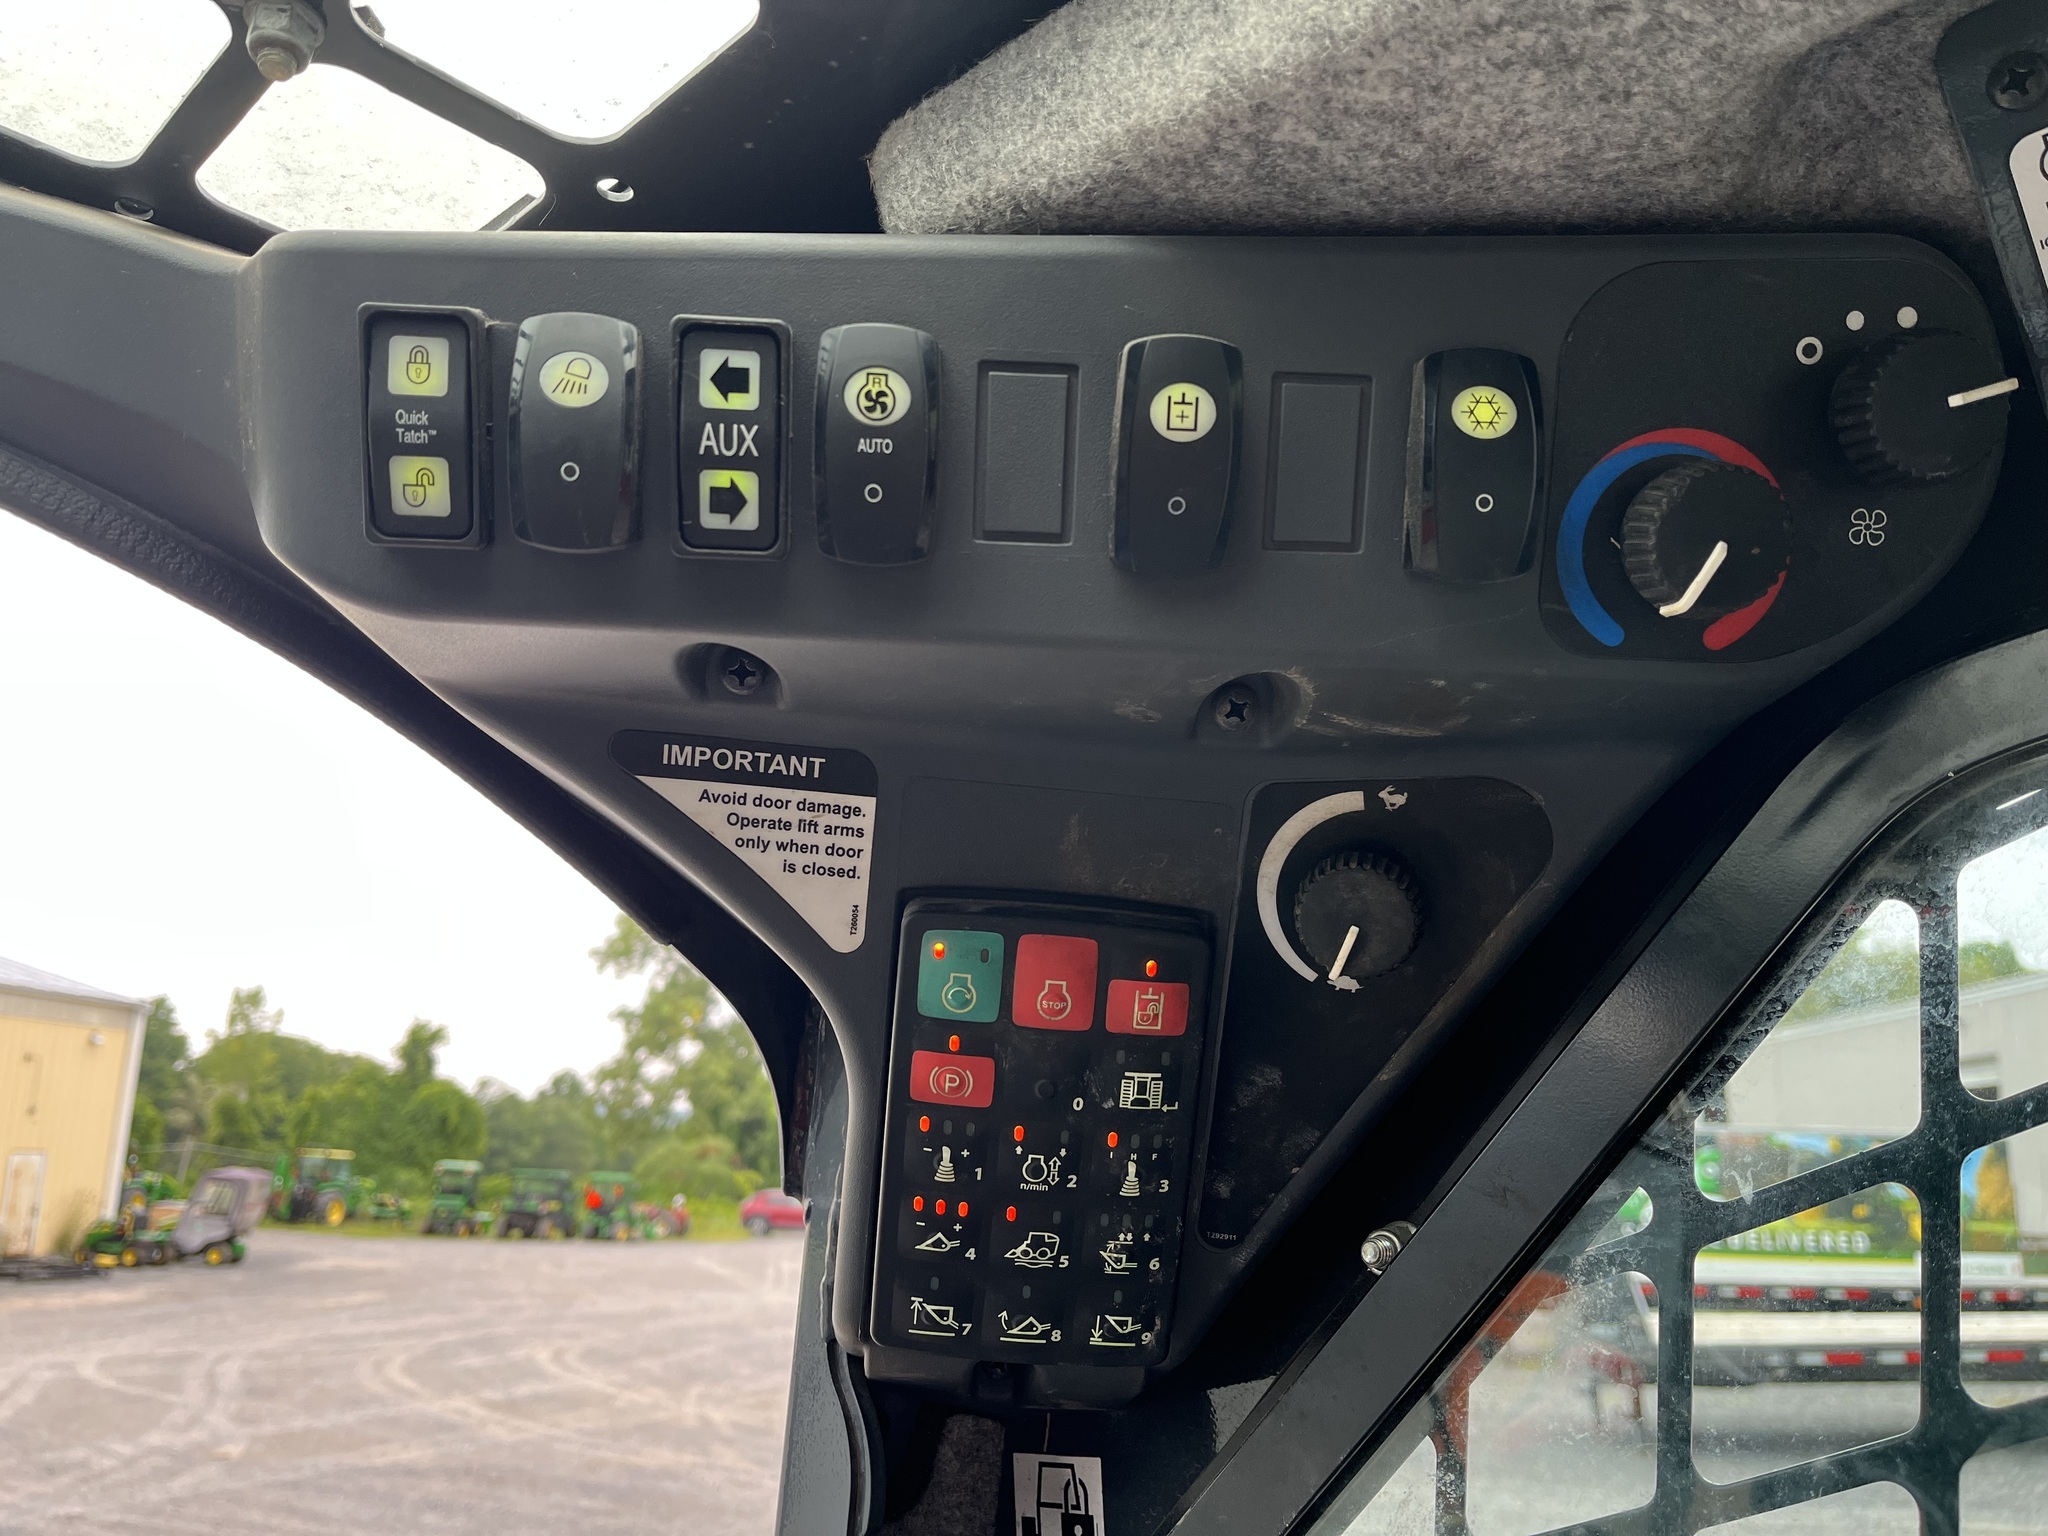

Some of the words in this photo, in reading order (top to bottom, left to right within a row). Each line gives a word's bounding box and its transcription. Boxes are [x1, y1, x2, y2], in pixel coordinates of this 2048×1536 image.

[395, 408, 429, 425] Quick
[699, 421, 760, 457] AUX
[857, 438, 893, 454] AUTO
[661, 743, 826, 778] IMPORTANT
[698, 788, 748, 806] Avoid
[752, 793, 792, 811] door
[796, 798, 867, 818] damage.
[726, 812, 793, 831] Operate
[797, 818, 819, 834] lift
[823, 824, 865, 838] arms
[734, 836, 771, 853] only
[775, 839, 820, 855] when
[825, 842, 864, 859] door
[782, 859, 797, 873] is
[802, 861, 862, 880] closed.
[850, 904, 859, 936] T260054
[1042, 1000, 1067, 1010] STOP
[1130, 1153, 1137, 1161] H
[1152, 1153, 1159, 1161] F
[974, 1167, 983, 1181] 1
[1066, 1174, 1078, 1188] 2
[1020, 1183, 1049, 1192] n/min
[1158, 1179, 1170, 1193] 3
[1207, 1231, 1237, 1241] T292911
[964, 1247, 977, 1260] 4
[1059, 1255, 1070, 1268] 5
[1149, 1257, 1160, 1271] 6
[962, 1323, 973, 1336] 7
[1050, 1329, 1062, 1343] 8
[1141, 1331, 1152, 1345] 9
